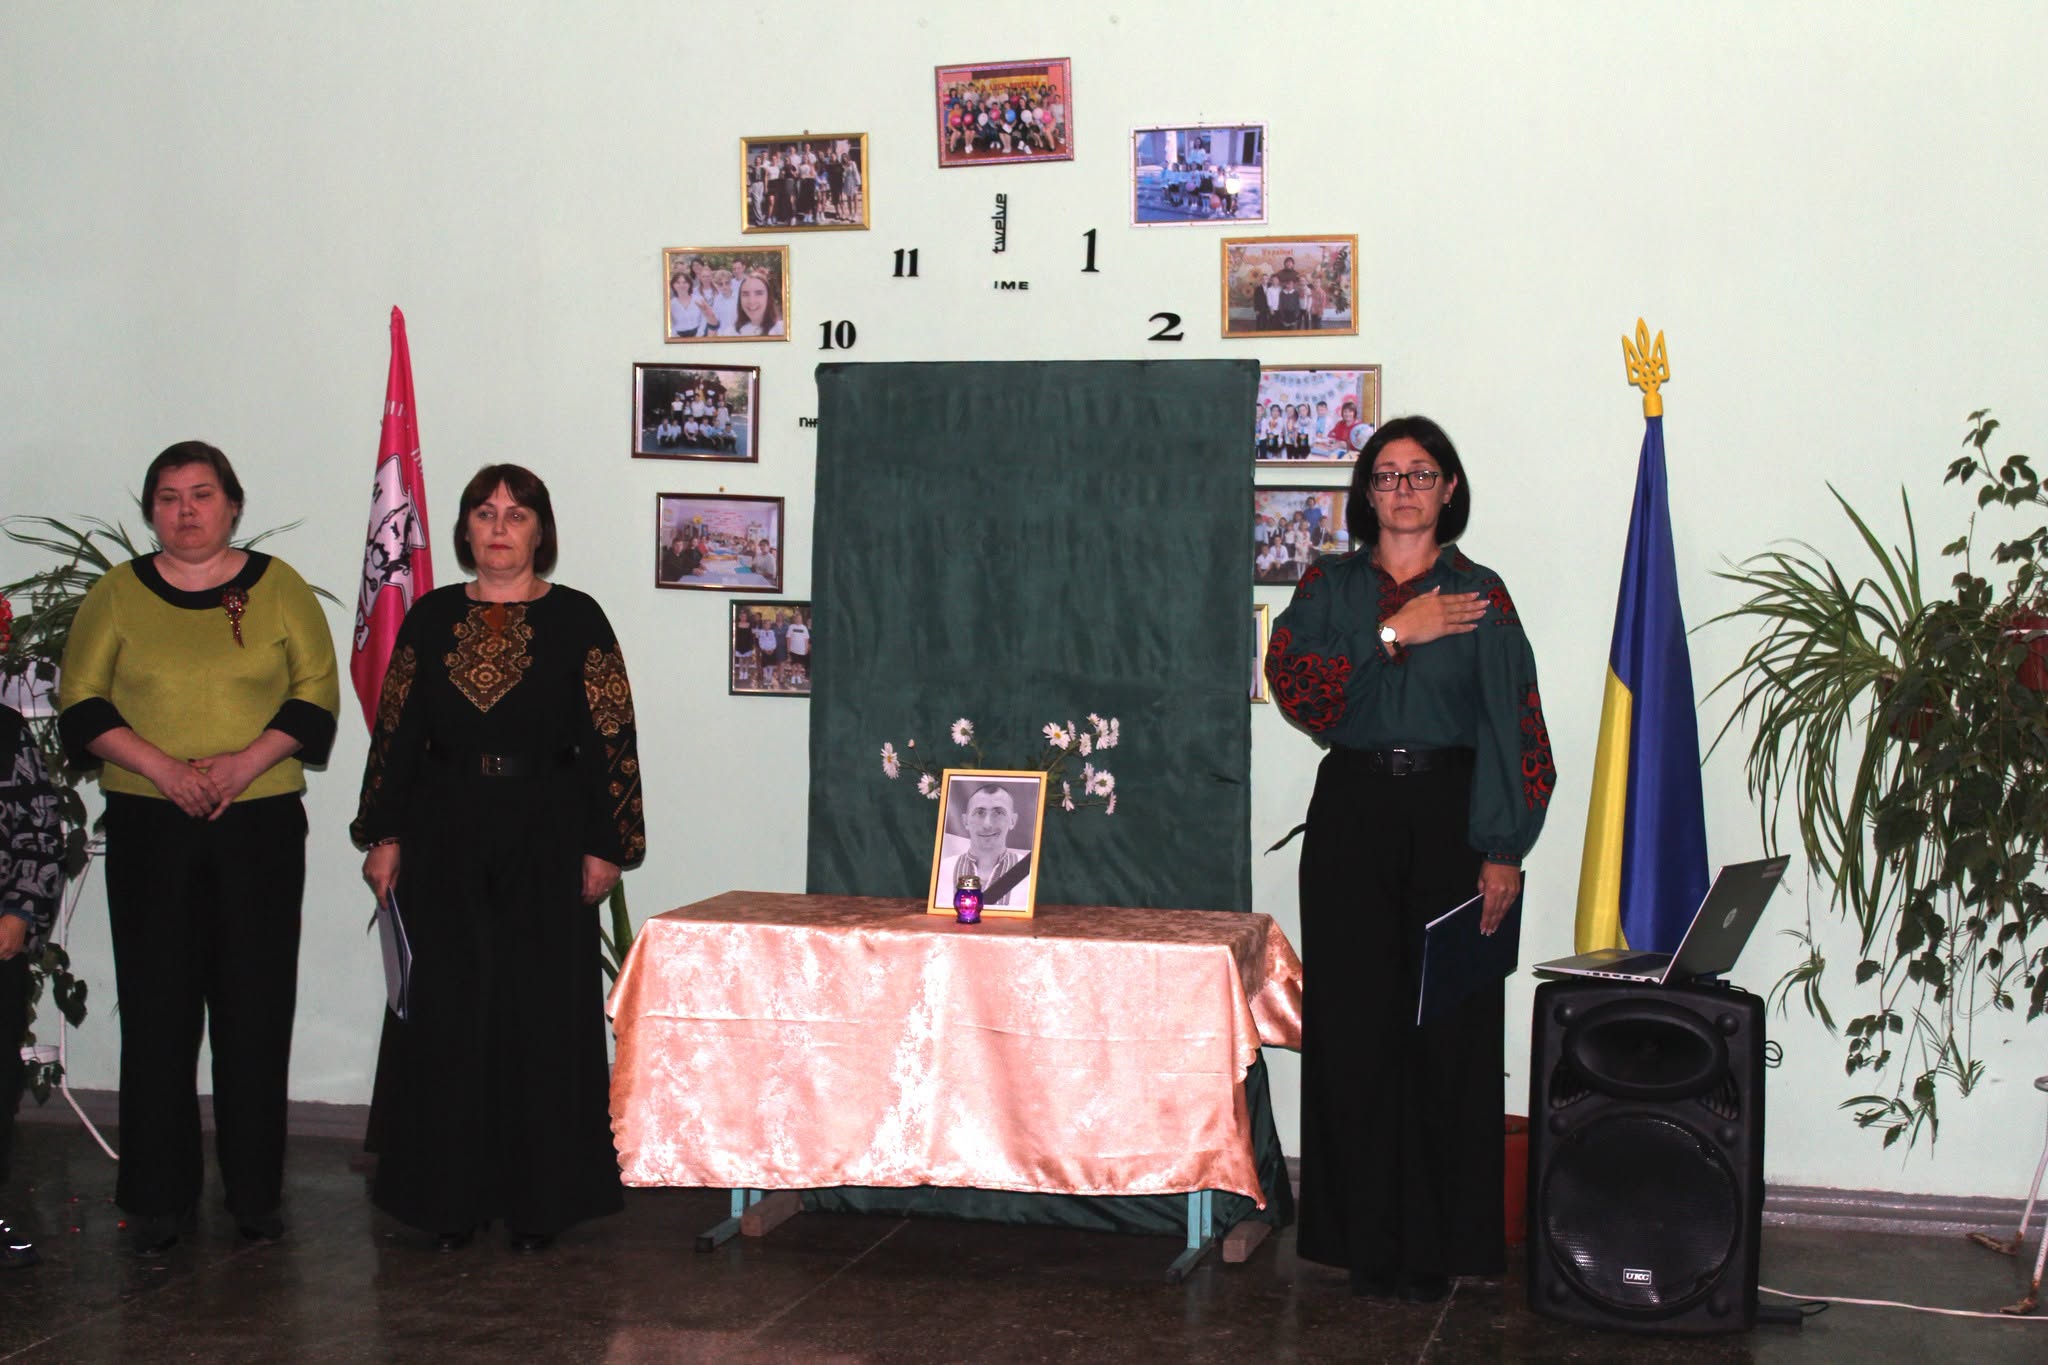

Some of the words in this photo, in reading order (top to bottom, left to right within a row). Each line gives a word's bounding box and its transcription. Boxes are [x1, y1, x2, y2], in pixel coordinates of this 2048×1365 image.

[991, 193, 1007, 254] twelve
[892, 248, 919, 278] 11
[1080, 228, 1100, 273] 1
[818, 320, 857, 350] 10
[1147, 312, 1185, 342] 2
